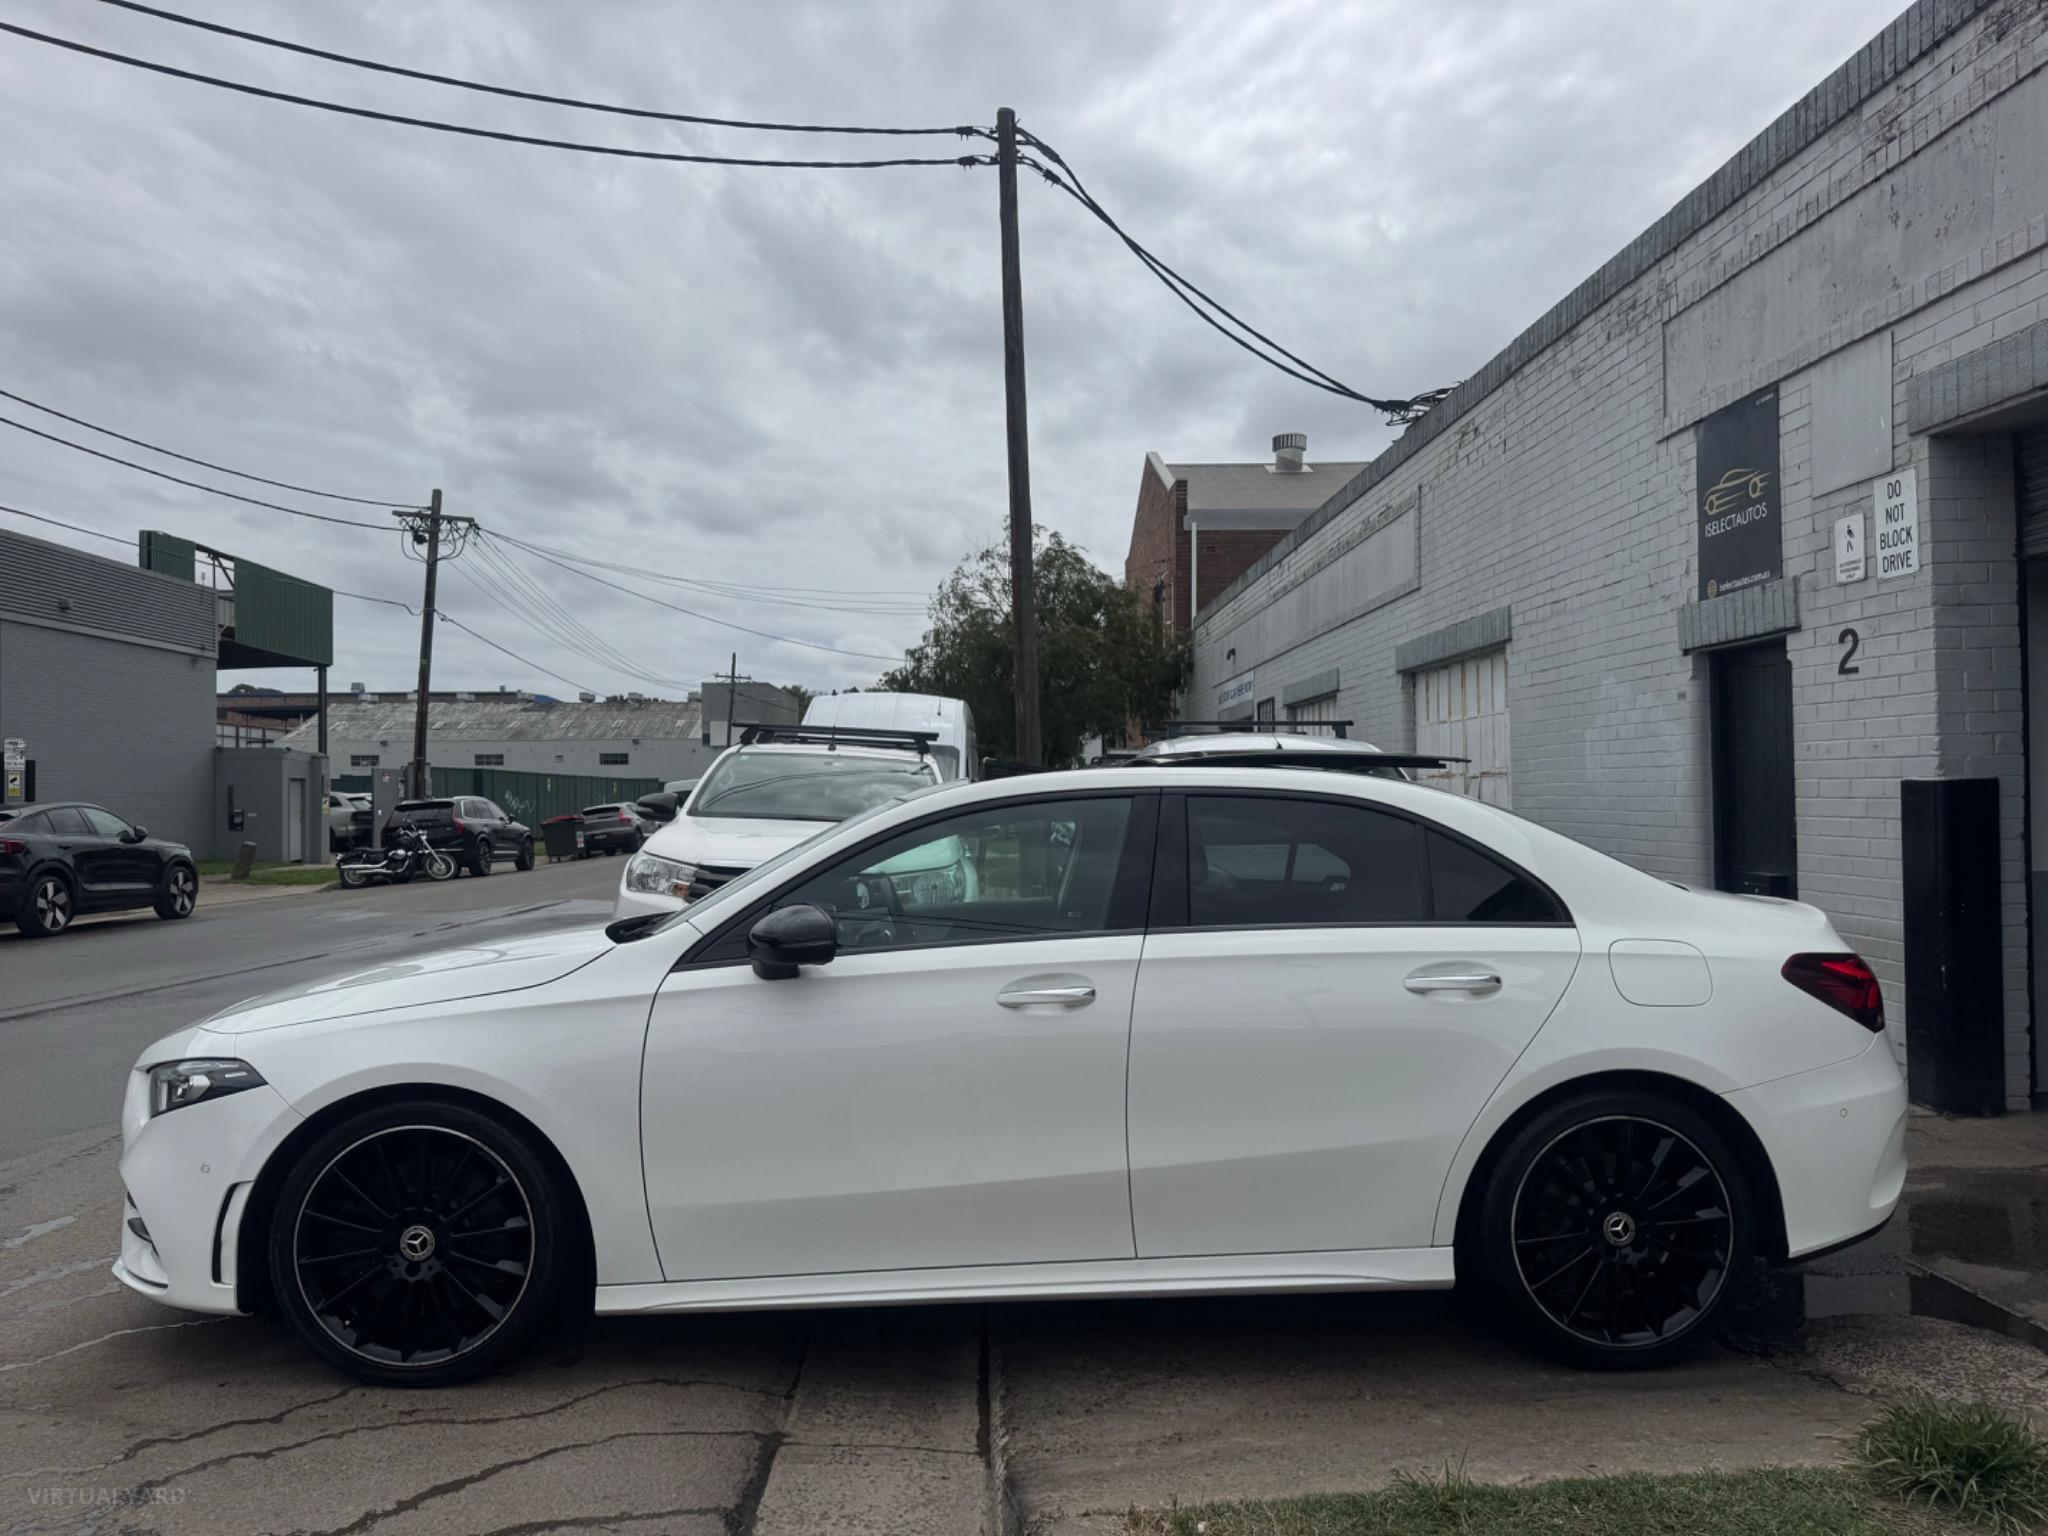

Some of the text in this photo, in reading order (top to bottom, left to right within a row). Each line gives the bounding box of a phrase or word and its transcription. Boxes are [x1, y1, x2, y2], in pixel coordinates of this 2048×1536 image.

[1887, 480, 1901, 499] DO
[1704, 502, 1768, 538] ISELECTAUTOS
[1885, 503, 1905, 524] NOT
[1880, 526, 1913, 550] BLOCK
[1882, 550, 1913, 573] DRIVE
[1838, 627, 1860, 676] 2
